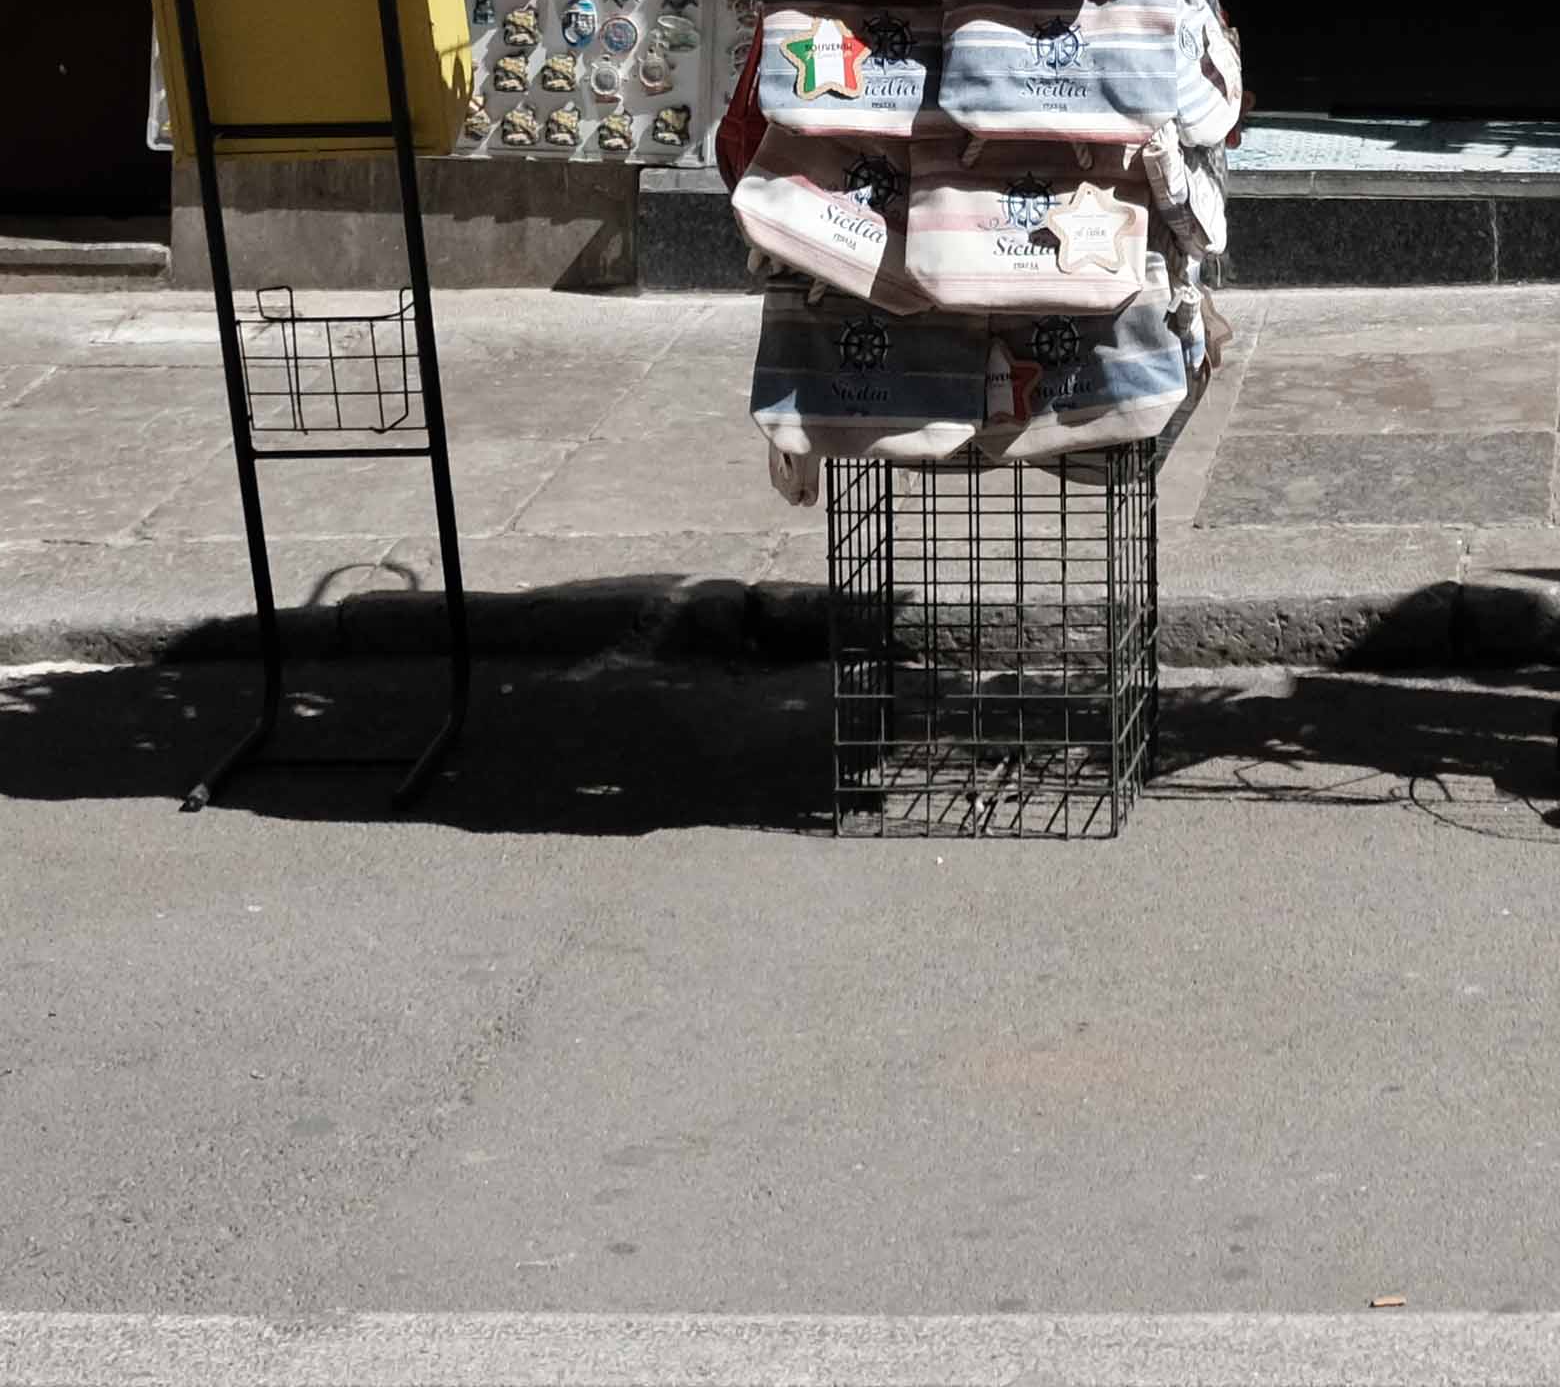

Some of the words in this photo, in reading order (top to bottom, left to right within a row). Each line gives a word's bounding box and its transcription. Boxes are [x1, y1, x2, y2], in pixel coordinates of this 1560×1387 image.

[864, 77, 917, 97] icilia
[1021, 77, 1088, 99] Sicilia
[820, 204, 884, 244] Sicilia
